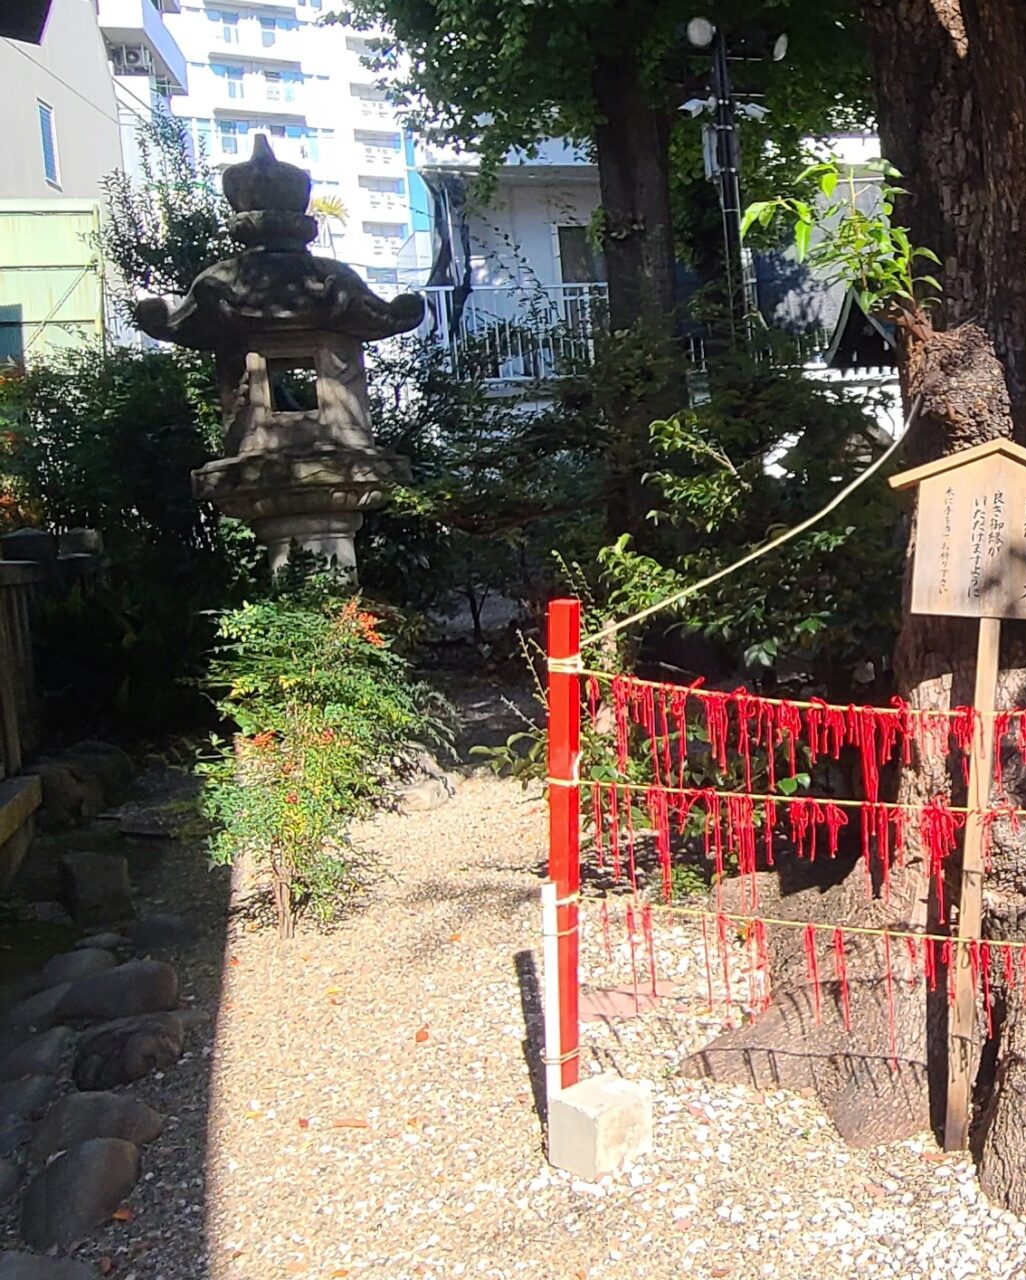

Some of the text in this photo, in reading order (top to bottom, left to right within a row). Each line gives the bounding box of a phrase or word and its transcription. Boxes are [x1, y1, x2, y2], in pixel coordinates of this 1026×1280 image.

[967, 495, 988, 598] いただけますように
[987, 489, 1005, 557] 良き御縁が
